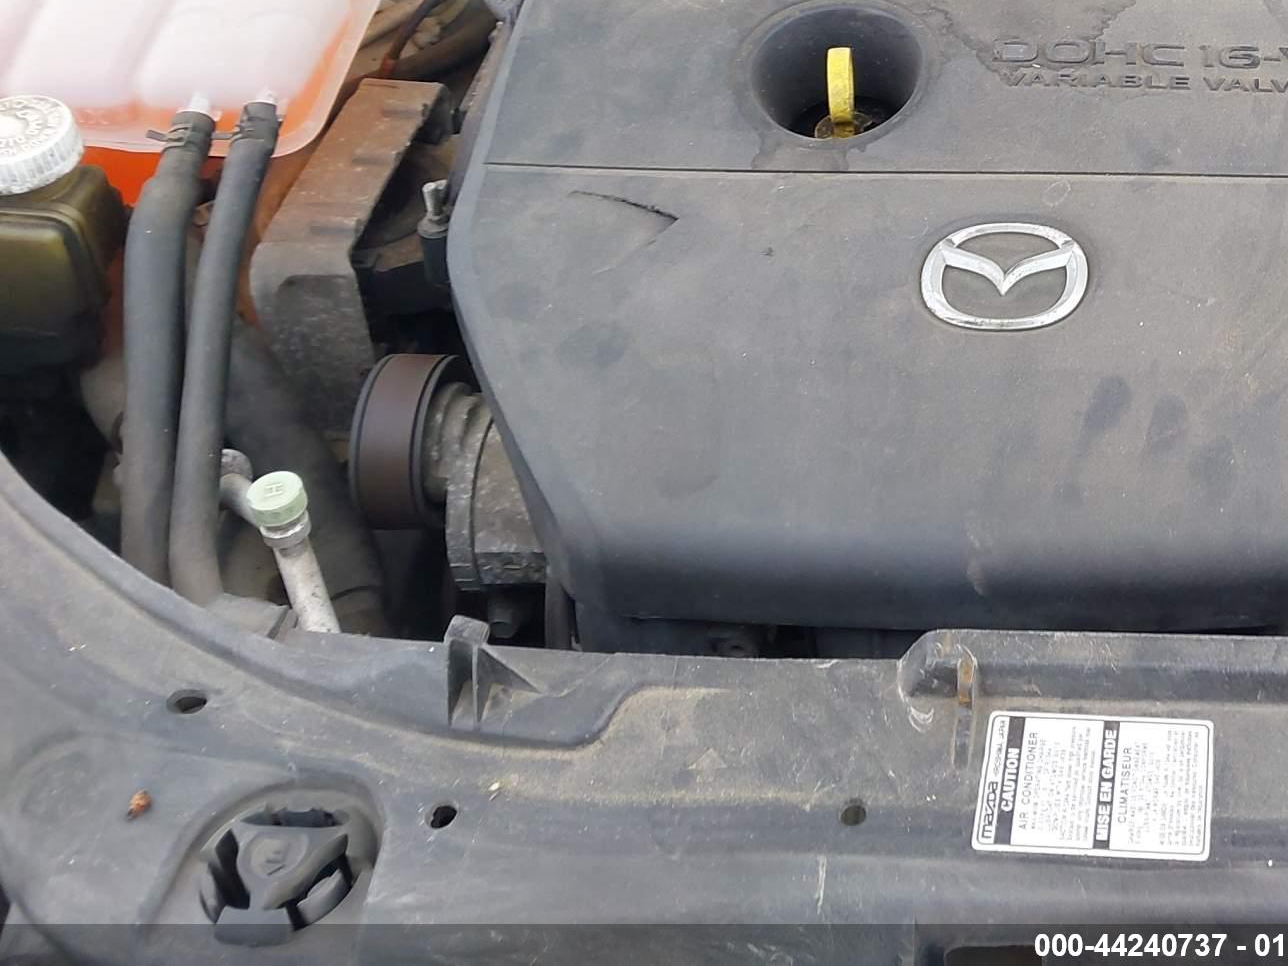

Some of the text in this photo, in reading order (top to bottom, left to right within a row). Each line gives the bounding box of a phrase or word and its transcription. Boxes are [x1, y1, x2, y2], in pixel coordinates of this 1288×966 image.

[992, 38, 1186, 68] DOHC
[999, 70, 1191, 91] VARIABLE
[1000, 747, 1019, 812] CAUTION
[1021, 731, 1038, 805] CONDITIONER
[1096, 729, 1117, 840] MISE EN GARDE
[1117, 746, 1131, 823] CLIMATISEUR
[1018, 811, 1028, 829] AIR
